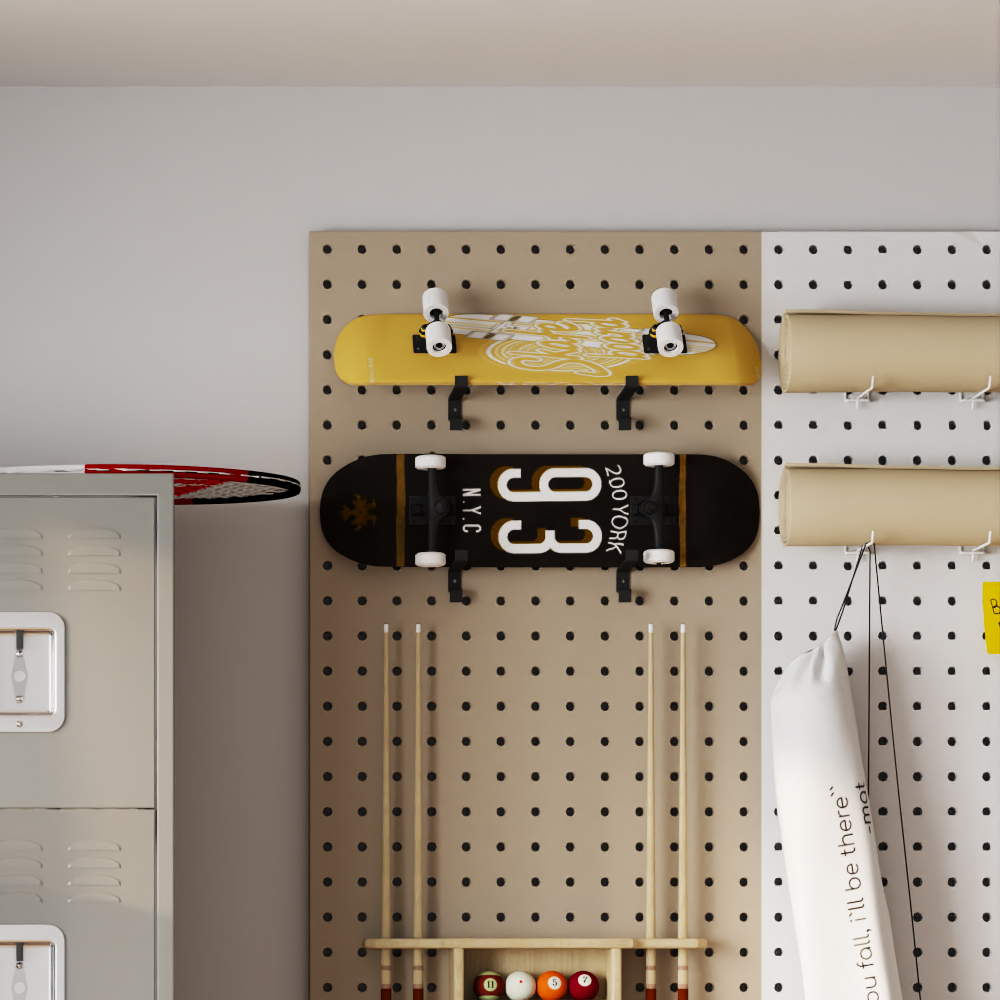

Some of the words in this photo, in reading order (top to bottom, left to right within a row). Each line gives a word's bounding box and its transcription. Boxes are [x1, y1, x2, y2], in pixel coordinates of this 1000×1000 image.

[604, 464, 628, 501] 200
[462, 488, 482, 533] N.Y.C
[493, 466, 602, 554] 93
[605, 504, 629, 555] YORK
[844, 863, 861, 892] be
[852, 928, 874, 969] fall,
